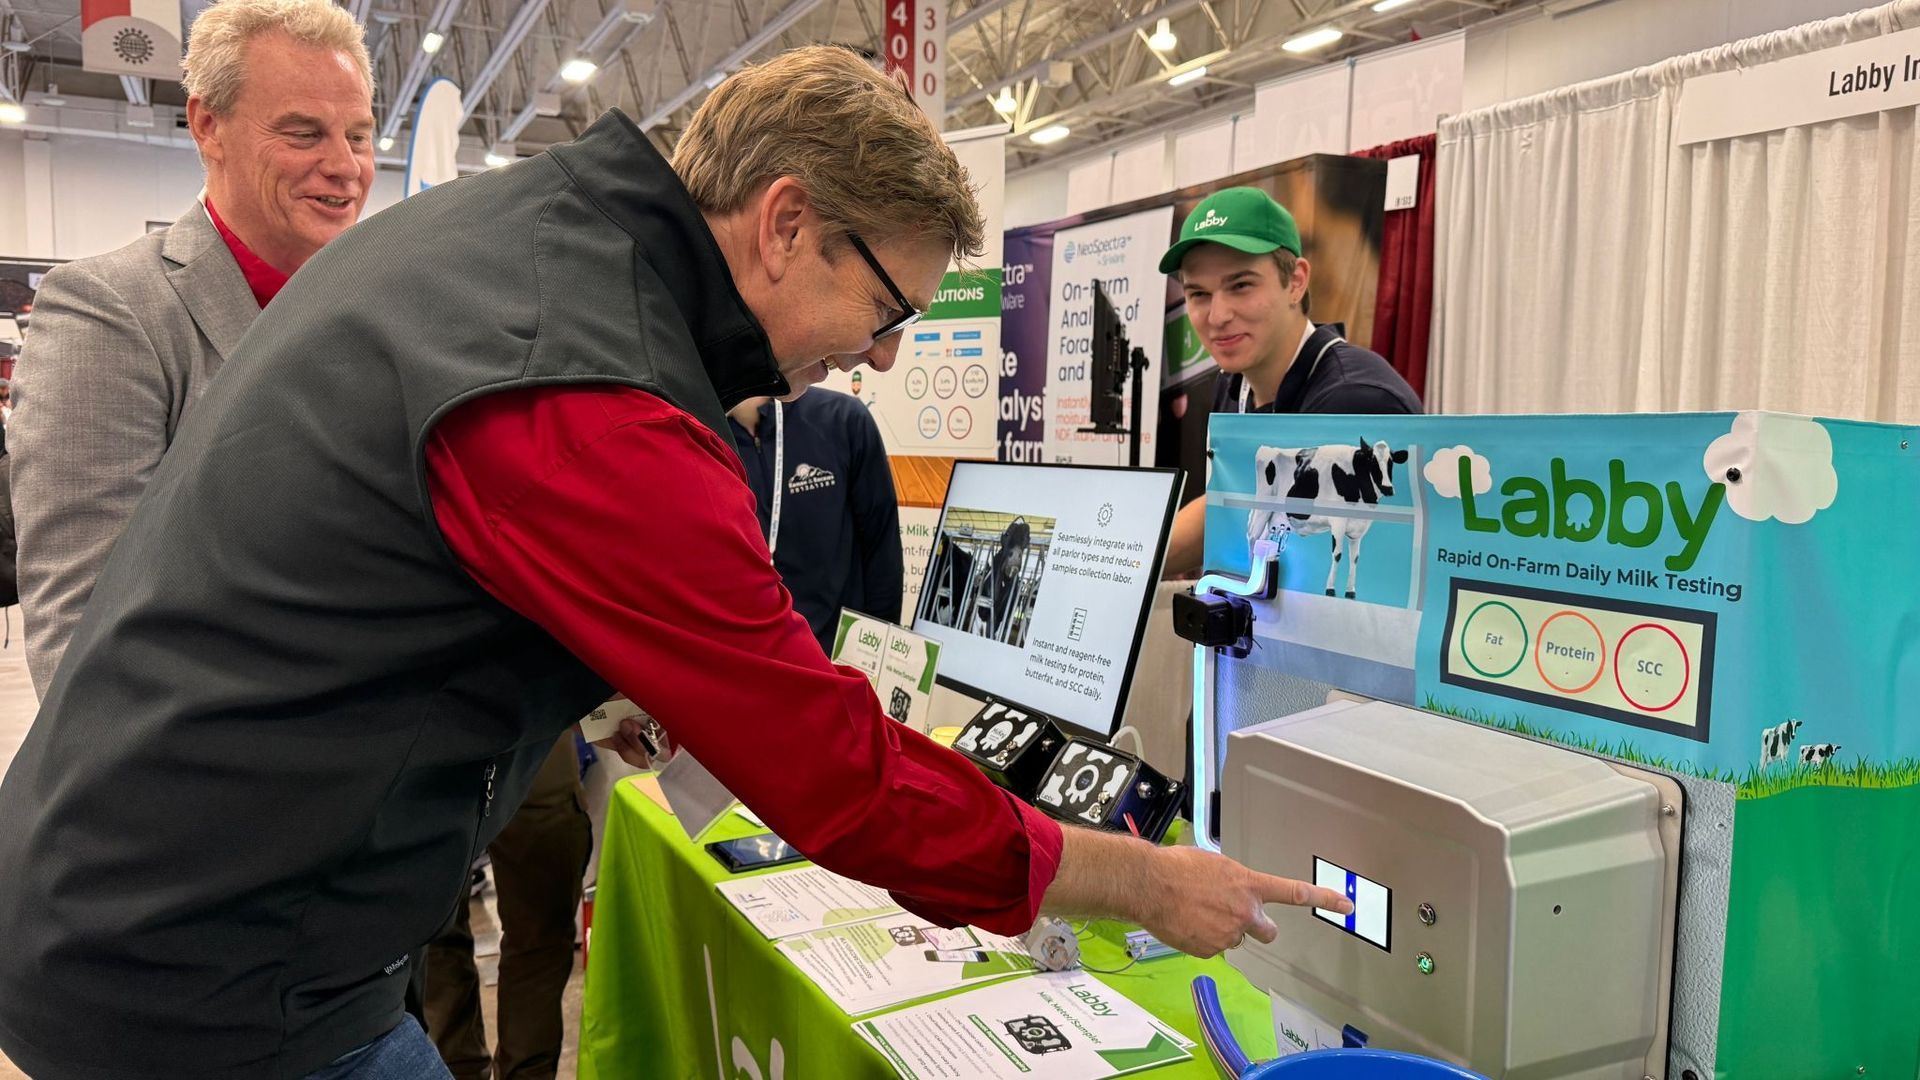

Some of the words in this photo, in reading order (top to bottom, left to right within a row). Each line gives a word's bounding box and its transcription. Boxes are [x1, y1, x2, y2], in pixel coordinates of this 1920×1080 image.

[923, 7, 937, 97] 300
[1828, 62, 1896, 97] Labby
[1194, 216, 1228, 232] Labby
[1125, 298, 1140, 322] of
[1060, 336, 1093, 357] Fora
[1058, 360, 1085, 381] and
[1458, 455, 1727, 572] Labby
[906, 524, 929, 537] Milk
[1057, 532, 1093, 547] Seamlessly
[1093, 537, 1125, 551] integrate
[1127, 541, 1143, 552] with
[1052, 547, 1060, 556] all
[1061, 548, 1080, 559] parlor
[1081, 552, 1100, 563] types
[1100, 554, 1114, 565] and
[1115, 556, 1141, 568] reduce
[1051, 563, 1078, 575] samples
[1078, 565, 1111, 581] collection
[1112, 571, 1133, 585] labor.
[1436, 548, 1482, 569] Rapid
[1486, 553, 1560, 577] On-Farm
[1566, 562, 1612, 587] Daily
[1617, 568, 1659, 589] Milk
[1665, 573, 1743, 602] Testing
[858, 627, 882, 652] Labby
[890, 636, 912, 659] Labby
[1485, 632, 1504, 646] Fat
[1033, 637, 1054, 650] Instant
[1055, 645, 1069, 656] and
[1069, 648, 1112, 667] reagent-free
[1546, 641, 1596, 662] Protein
[1029, 653, 1044, 665] milk
[1044, 657, 1067, 674] testing
[1067, 663, 1078, 675] for
[1078, 669, 1105, 685] protein,
[1636, 659, 1663, 676] SCC
[1025, 667, 1054, 685] butterfat,
[1055, 678, 1068, 689] and
[1068, 681, 1082, 694] SCC
[1083, 685, 1102, 701] daily.
[1066, 984, 1118, 1018] Labby
[1280, 1022, 1309, 1053] Labby
